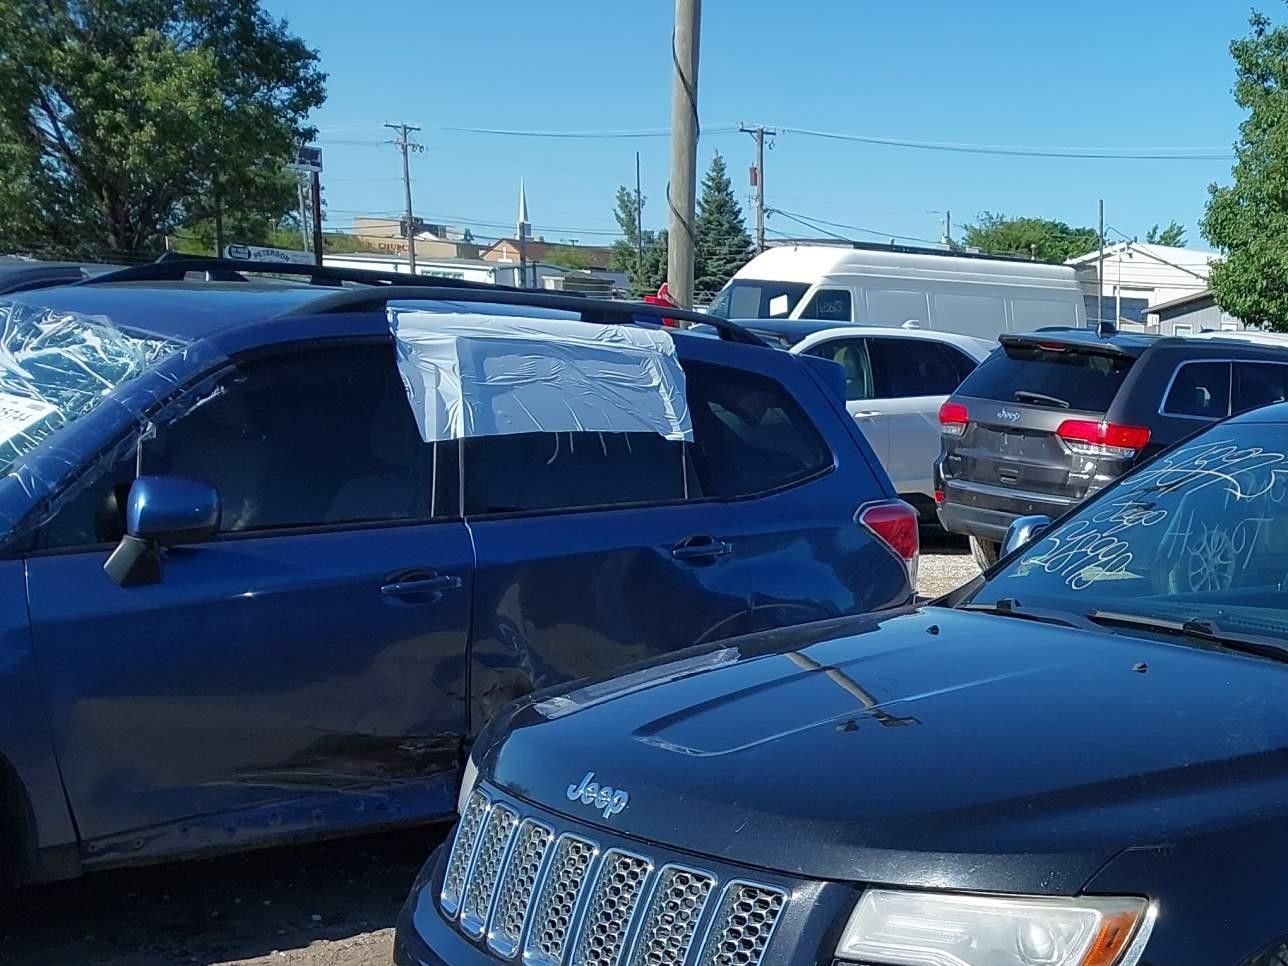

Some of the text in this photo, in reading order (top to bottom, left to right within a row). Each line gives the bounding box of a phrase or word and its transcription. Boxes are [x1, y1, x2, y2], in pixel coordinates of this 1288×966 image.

[377, 242, 409, 251] CHURC
[253, 249, 290, 263] PETERSON
[997, 408, 1021, 422] Jeep
[566, 771, 630, 819] Jeep
